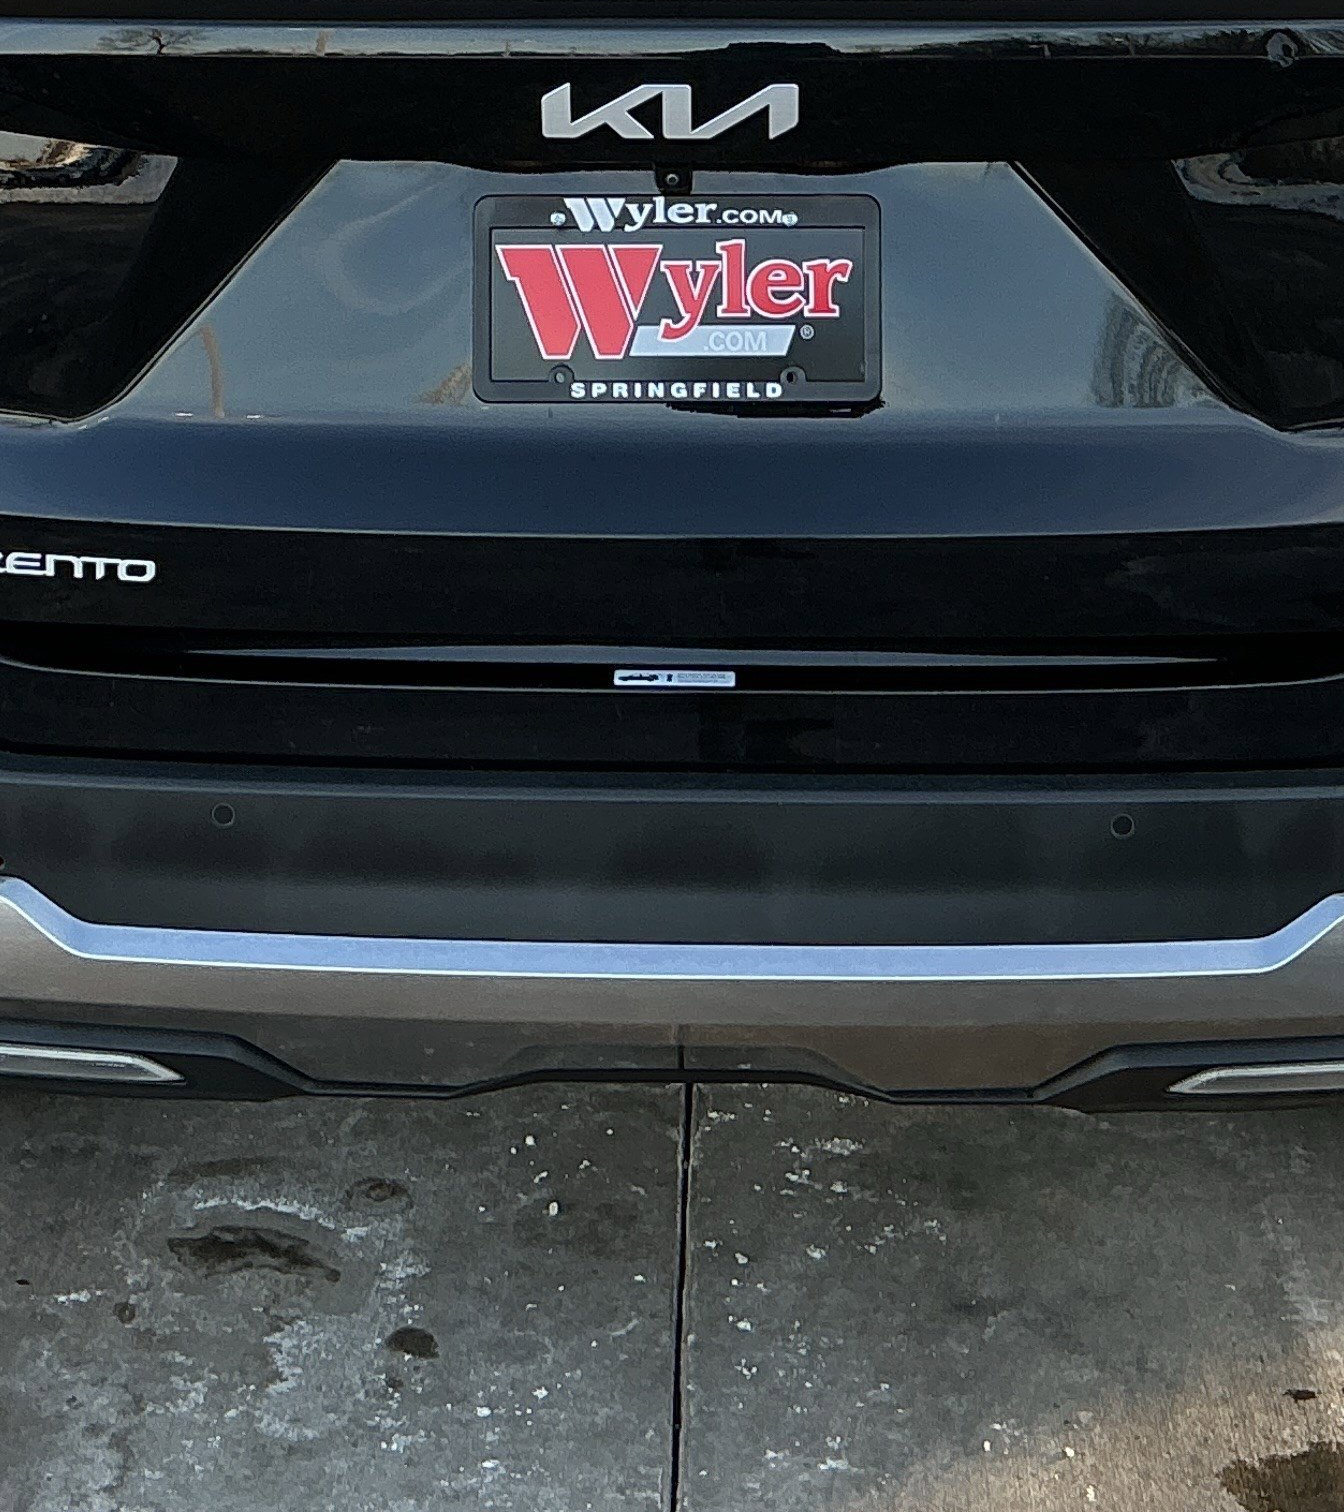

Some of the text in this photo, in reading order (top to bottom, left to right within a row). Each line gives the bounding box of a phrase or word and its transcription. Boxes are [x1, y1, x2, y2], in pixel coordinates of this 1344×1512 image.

[541, 82, 799, 140] KIA
[495, 239, 853, 360] Wyler
[570, 382, 784, 400] SPRINGFIELD
